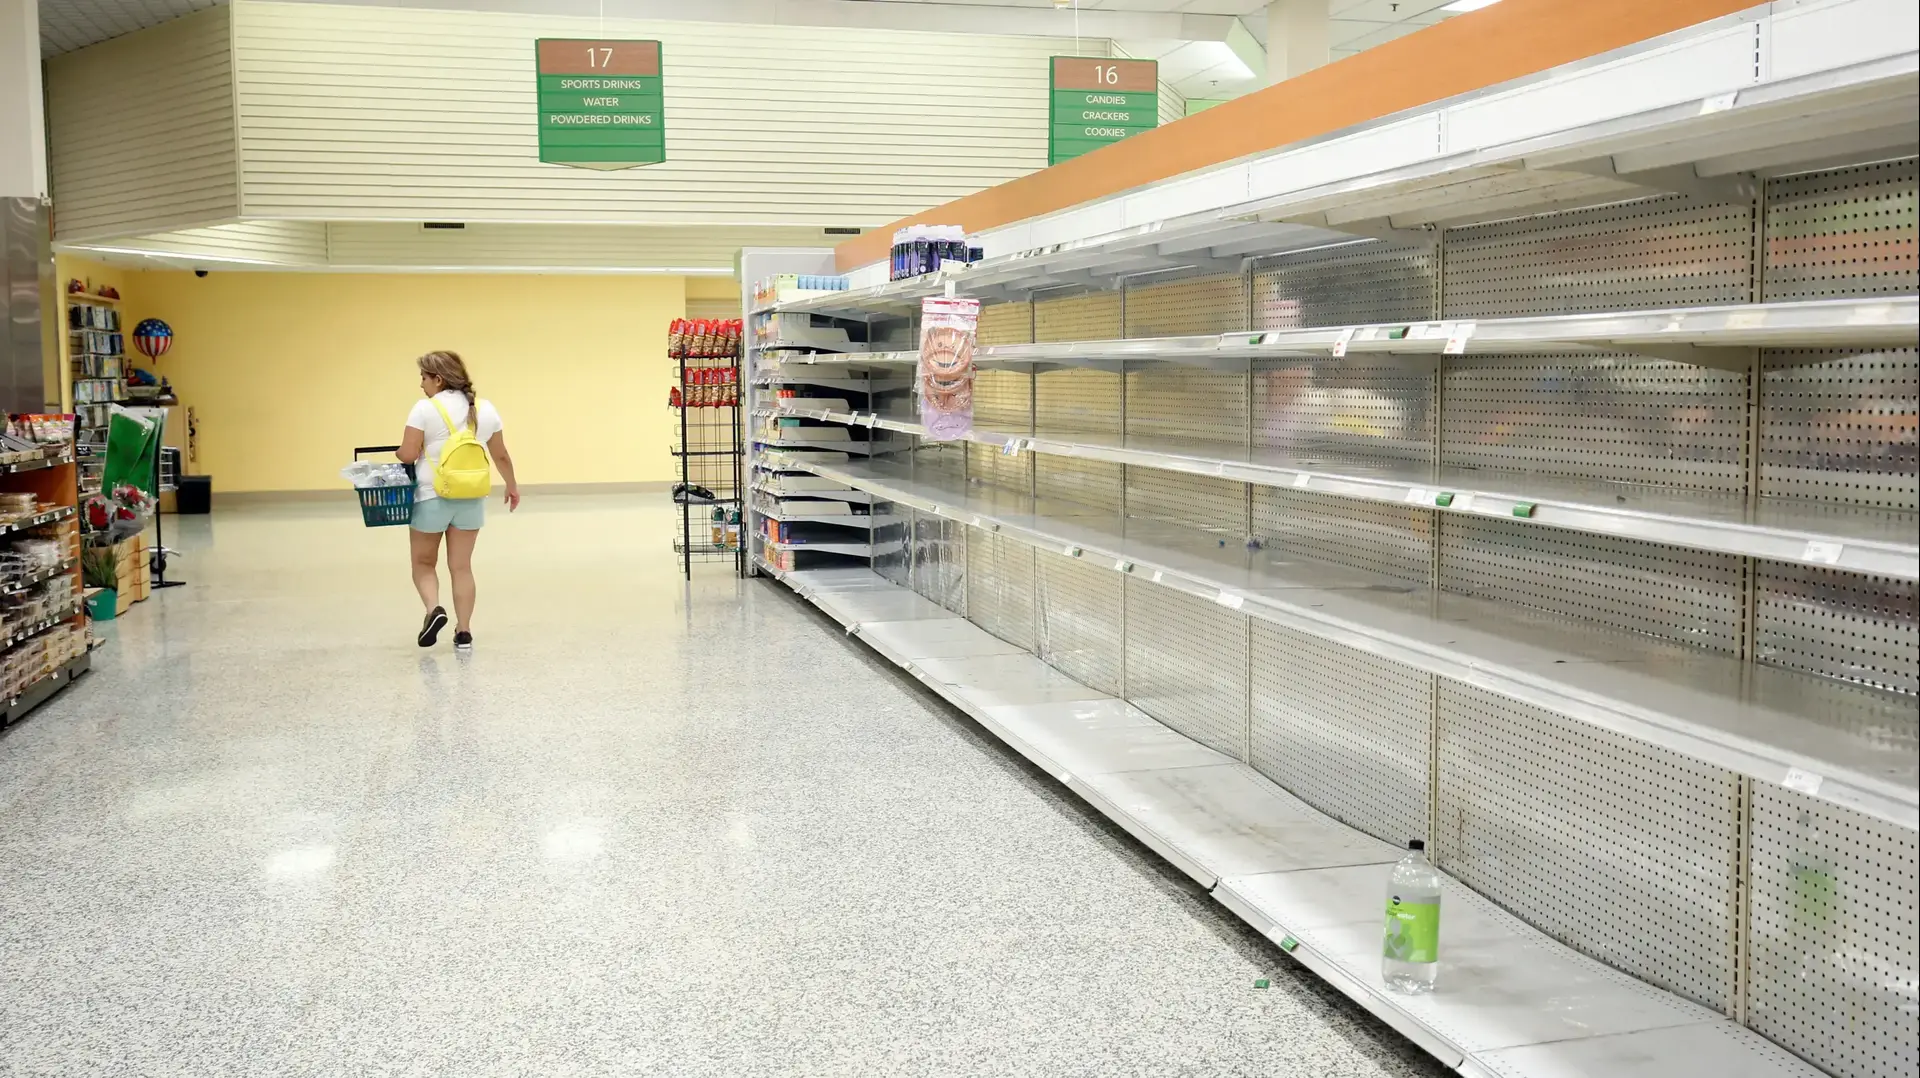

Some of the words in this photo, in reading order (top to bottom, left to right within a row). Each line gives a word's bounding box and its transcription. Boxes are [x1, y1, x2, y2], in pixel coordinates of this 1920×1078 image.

[587, 47, 613, 67] 17
[1095, 65, 1118, 84] 16
[561, 79, 601, 89] SPORTS
[602, 80, 641, 89] DRINKS
[583, 97, 619, 106] WATER
[1086, 95, 1126, 104] CANDIES
[551, 115, 611, 124] POWDERED
[613, 115, 651, 124] DRINKS
[1082, 111, 1129, 121] CRACKERS
[1084, 127, 1125, 137] COOKIES
